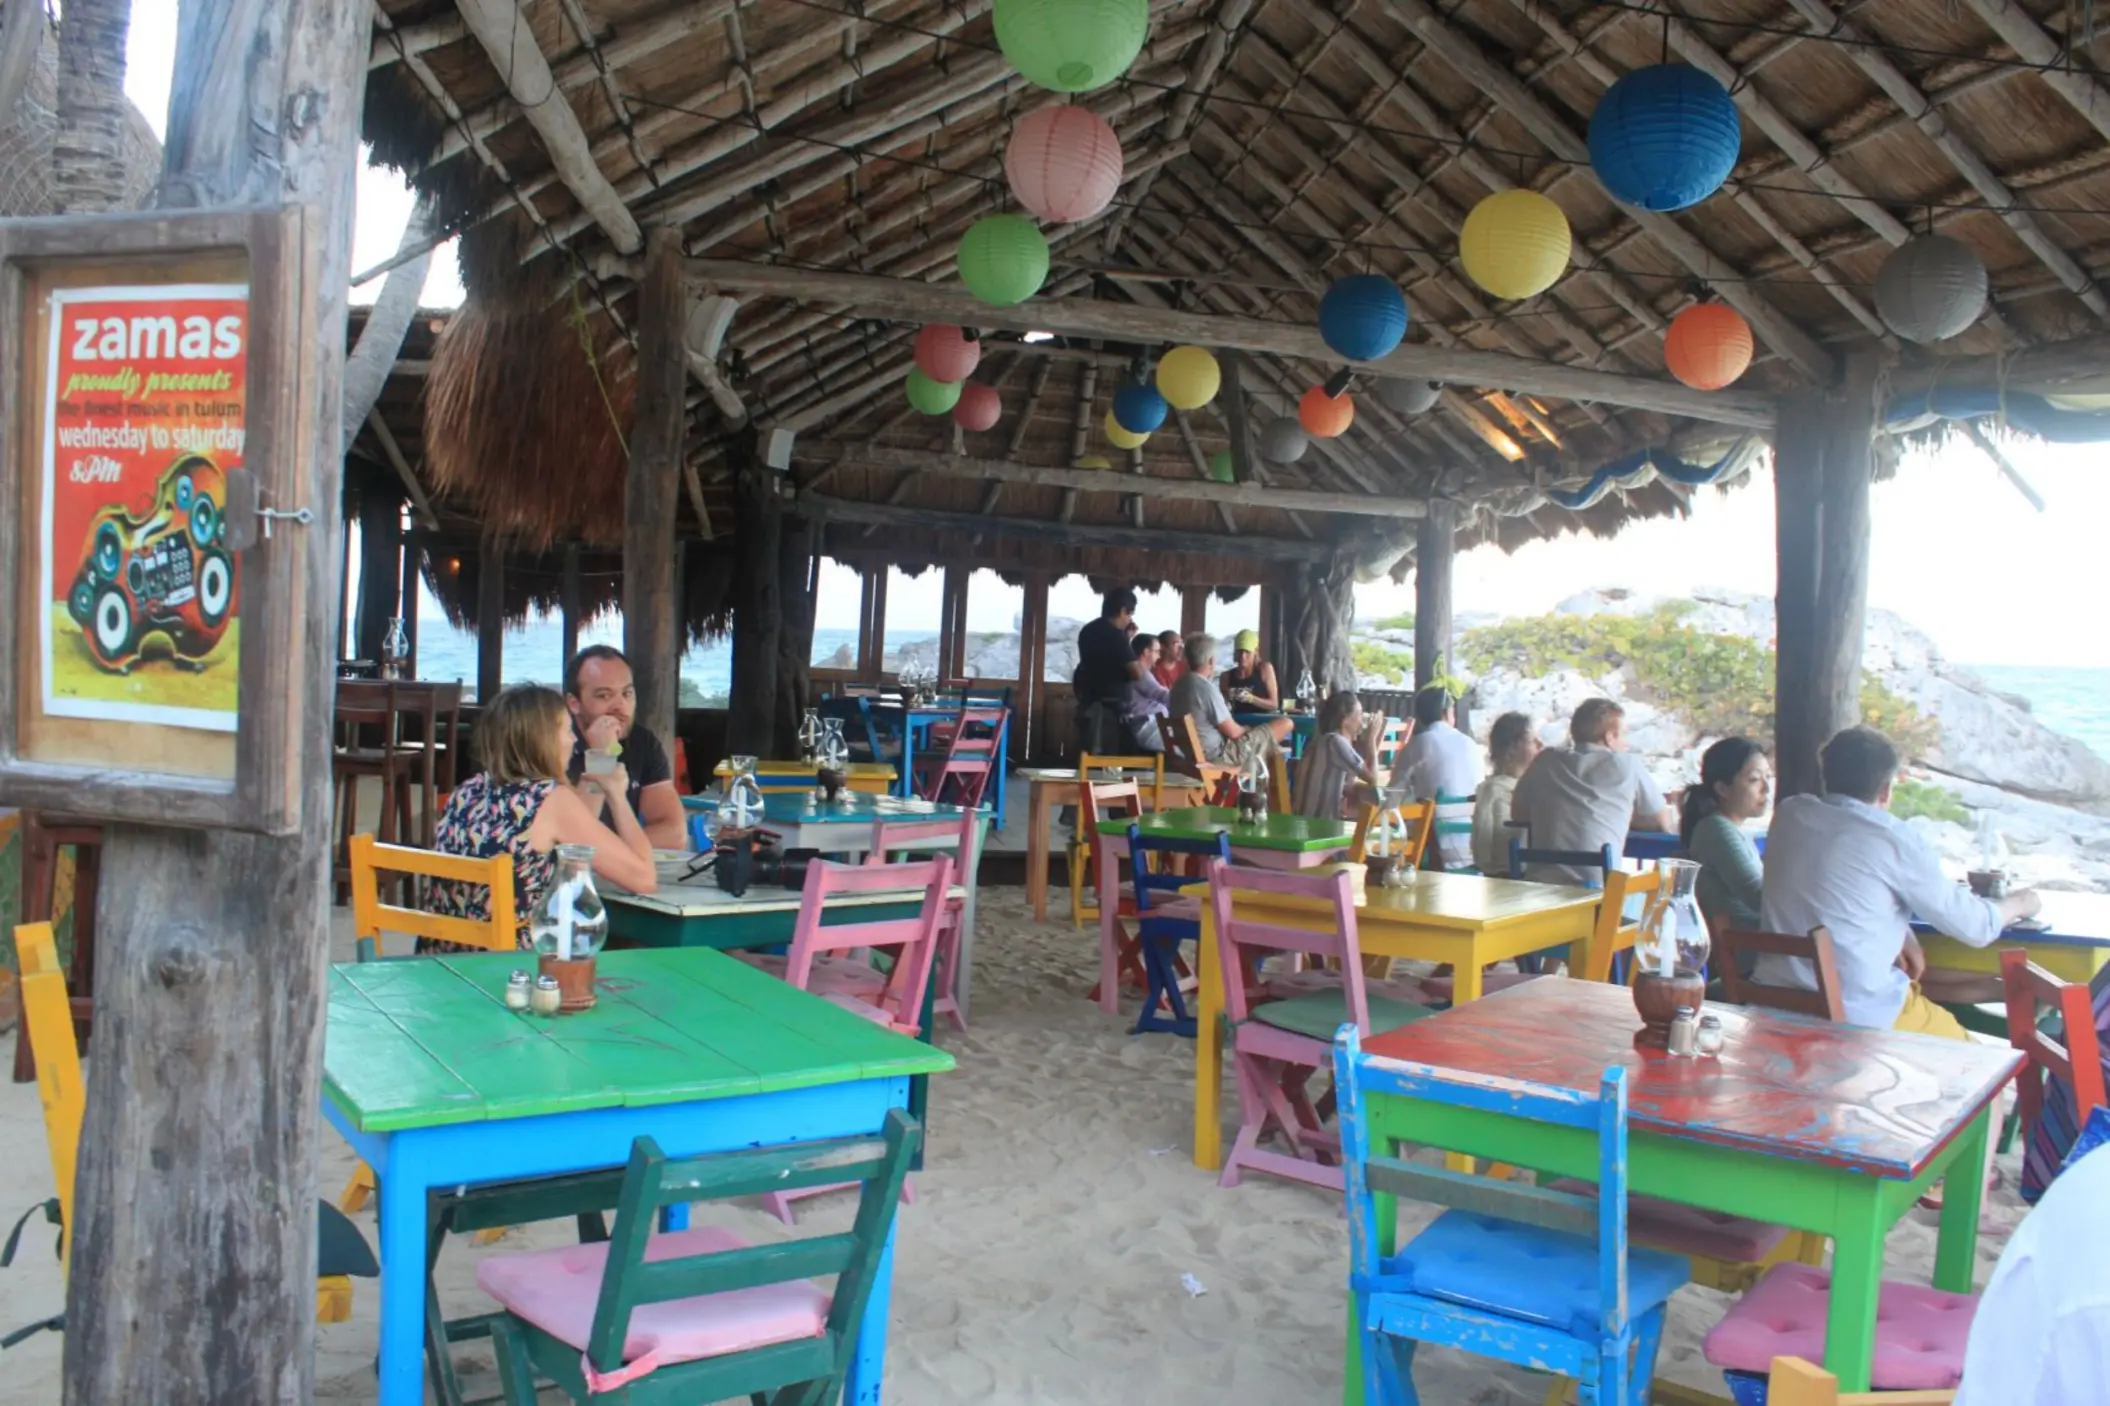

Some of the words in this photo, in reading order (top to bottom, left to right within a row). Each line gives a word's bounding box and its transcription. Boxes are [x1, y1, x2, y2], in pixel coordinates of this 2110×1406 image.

[72, 315, 241, 360] zamas
[62, 366, 140, 400] proudly
[141, 369, 233, 400] presents
[176, 401, 190, 416] in
[194, 401, 241, 416] tulum
[58, 419, 148, 456] wednesday
[151, 423, 169, 448] to
[173, 419, 246, 457] saturday
